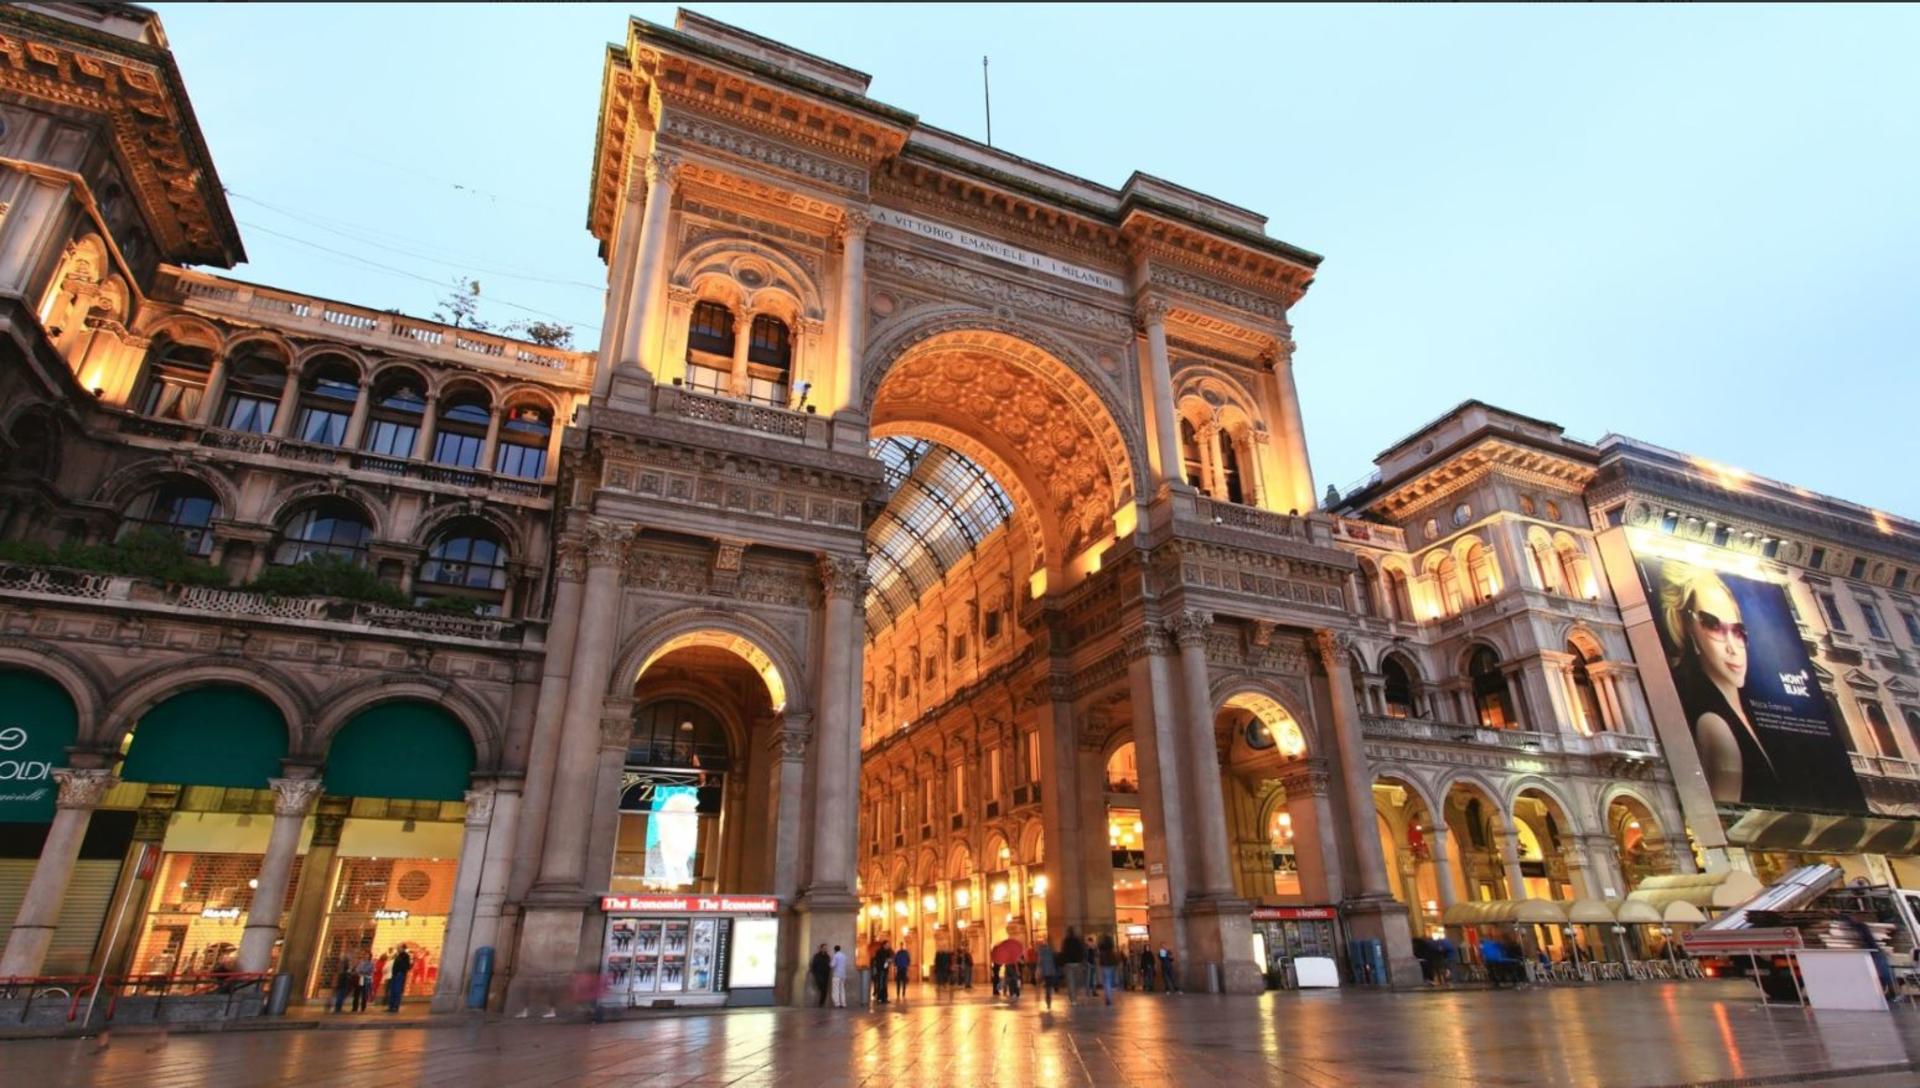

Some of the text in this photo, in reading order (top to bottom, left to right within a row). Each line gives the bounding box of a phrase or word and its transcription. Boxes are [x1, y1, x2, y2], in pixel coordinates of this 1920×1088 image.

[878, 211, 886, 221] A
[895, 215, 954, 240] VITTORIO
[960, 235, 1026, 262] EMANUELE
[1061, 266, 1113, 288] MILANESI
[1779, 672, 1805, 686] MONT
[1783, 683, 1810, 697] BLANC
[606, 898, 775, 911] The Economist The Economist
